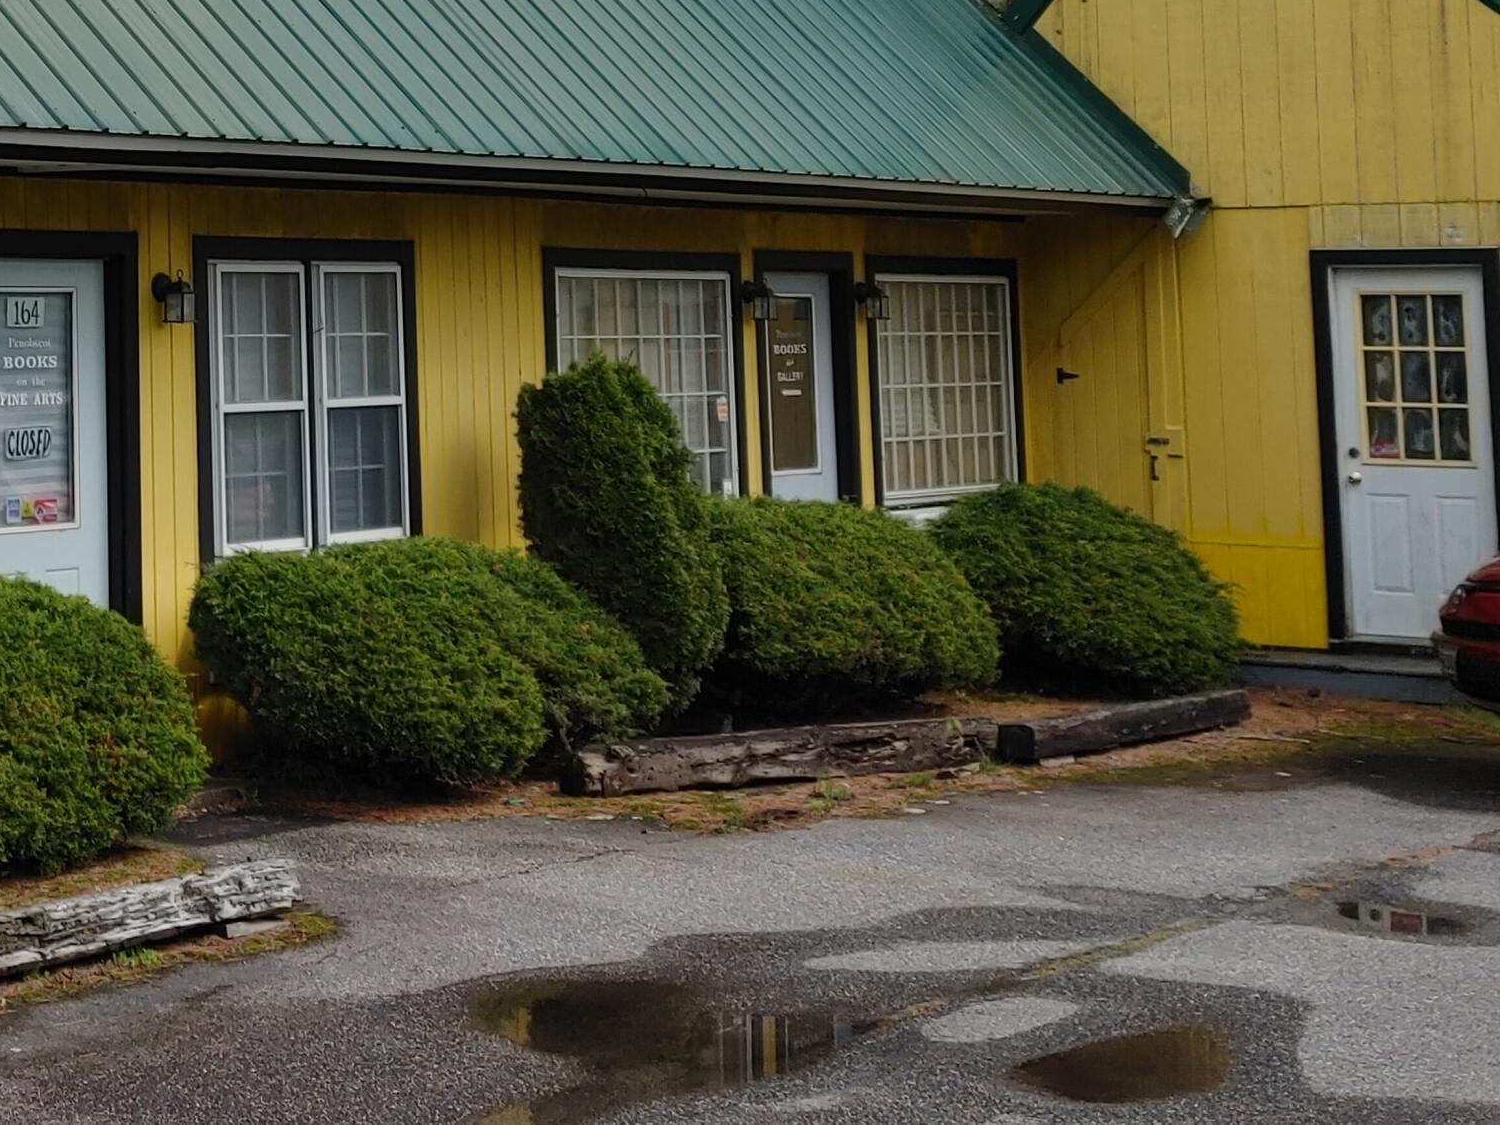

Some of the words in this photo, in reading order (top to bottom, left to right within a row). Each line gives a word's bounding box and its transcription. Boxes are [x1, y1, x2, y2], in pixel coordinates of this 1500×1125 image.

[13, 300, 40, 325] 164
[773, 344, 807, 355] BOOKS
[3, 355, 58, 369] BOOKS
[0, 392, 28, 406] FINE
[34, 392, 64, 406] ARTS
[8, 429, 51, 456] CLOSED
